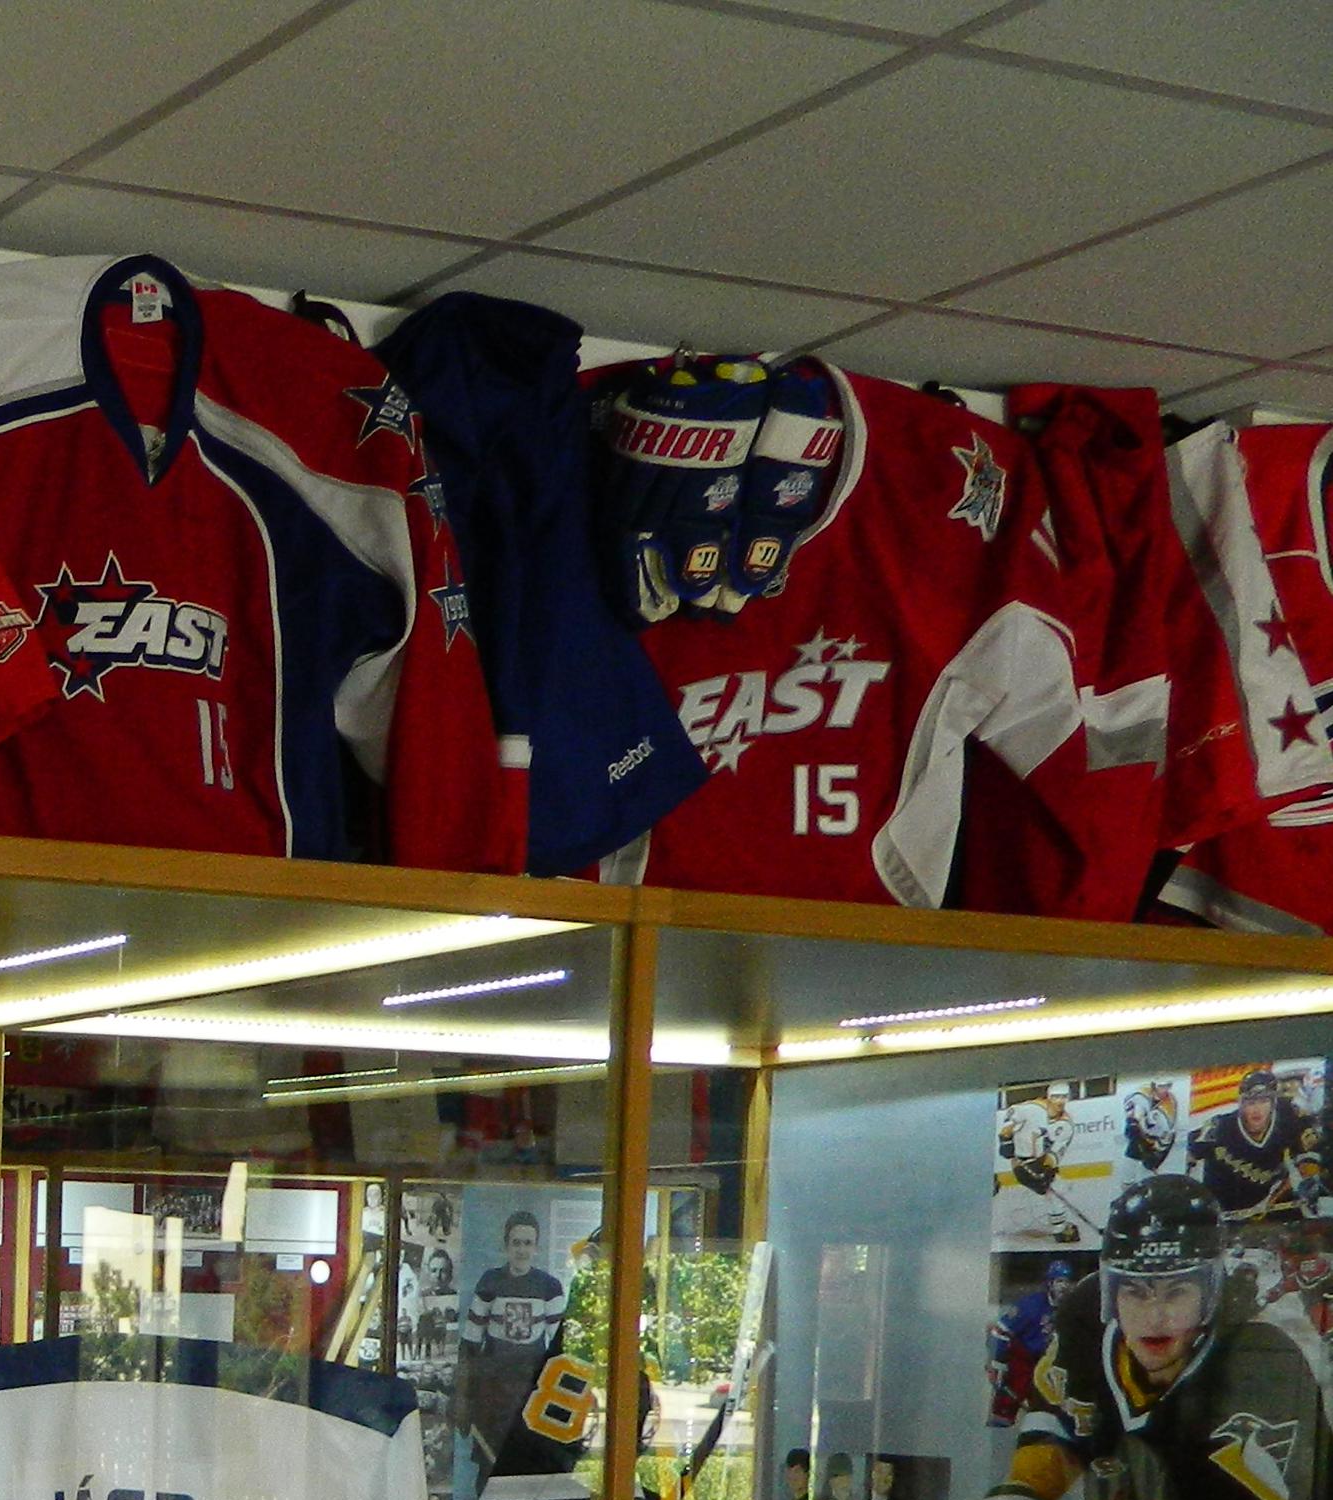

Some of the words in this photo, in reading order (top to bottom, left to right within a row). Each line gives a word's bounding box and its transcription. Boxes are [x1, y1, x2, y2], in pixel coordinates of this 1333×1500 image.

[66, 600, 229, 671] EAST
[677, 659, 893, 748] EAST
[606, 736, 656, 785] Reebok
[792, 763, 861, 836] 15
[1133, 1240, 1183, 1258] JOFA
